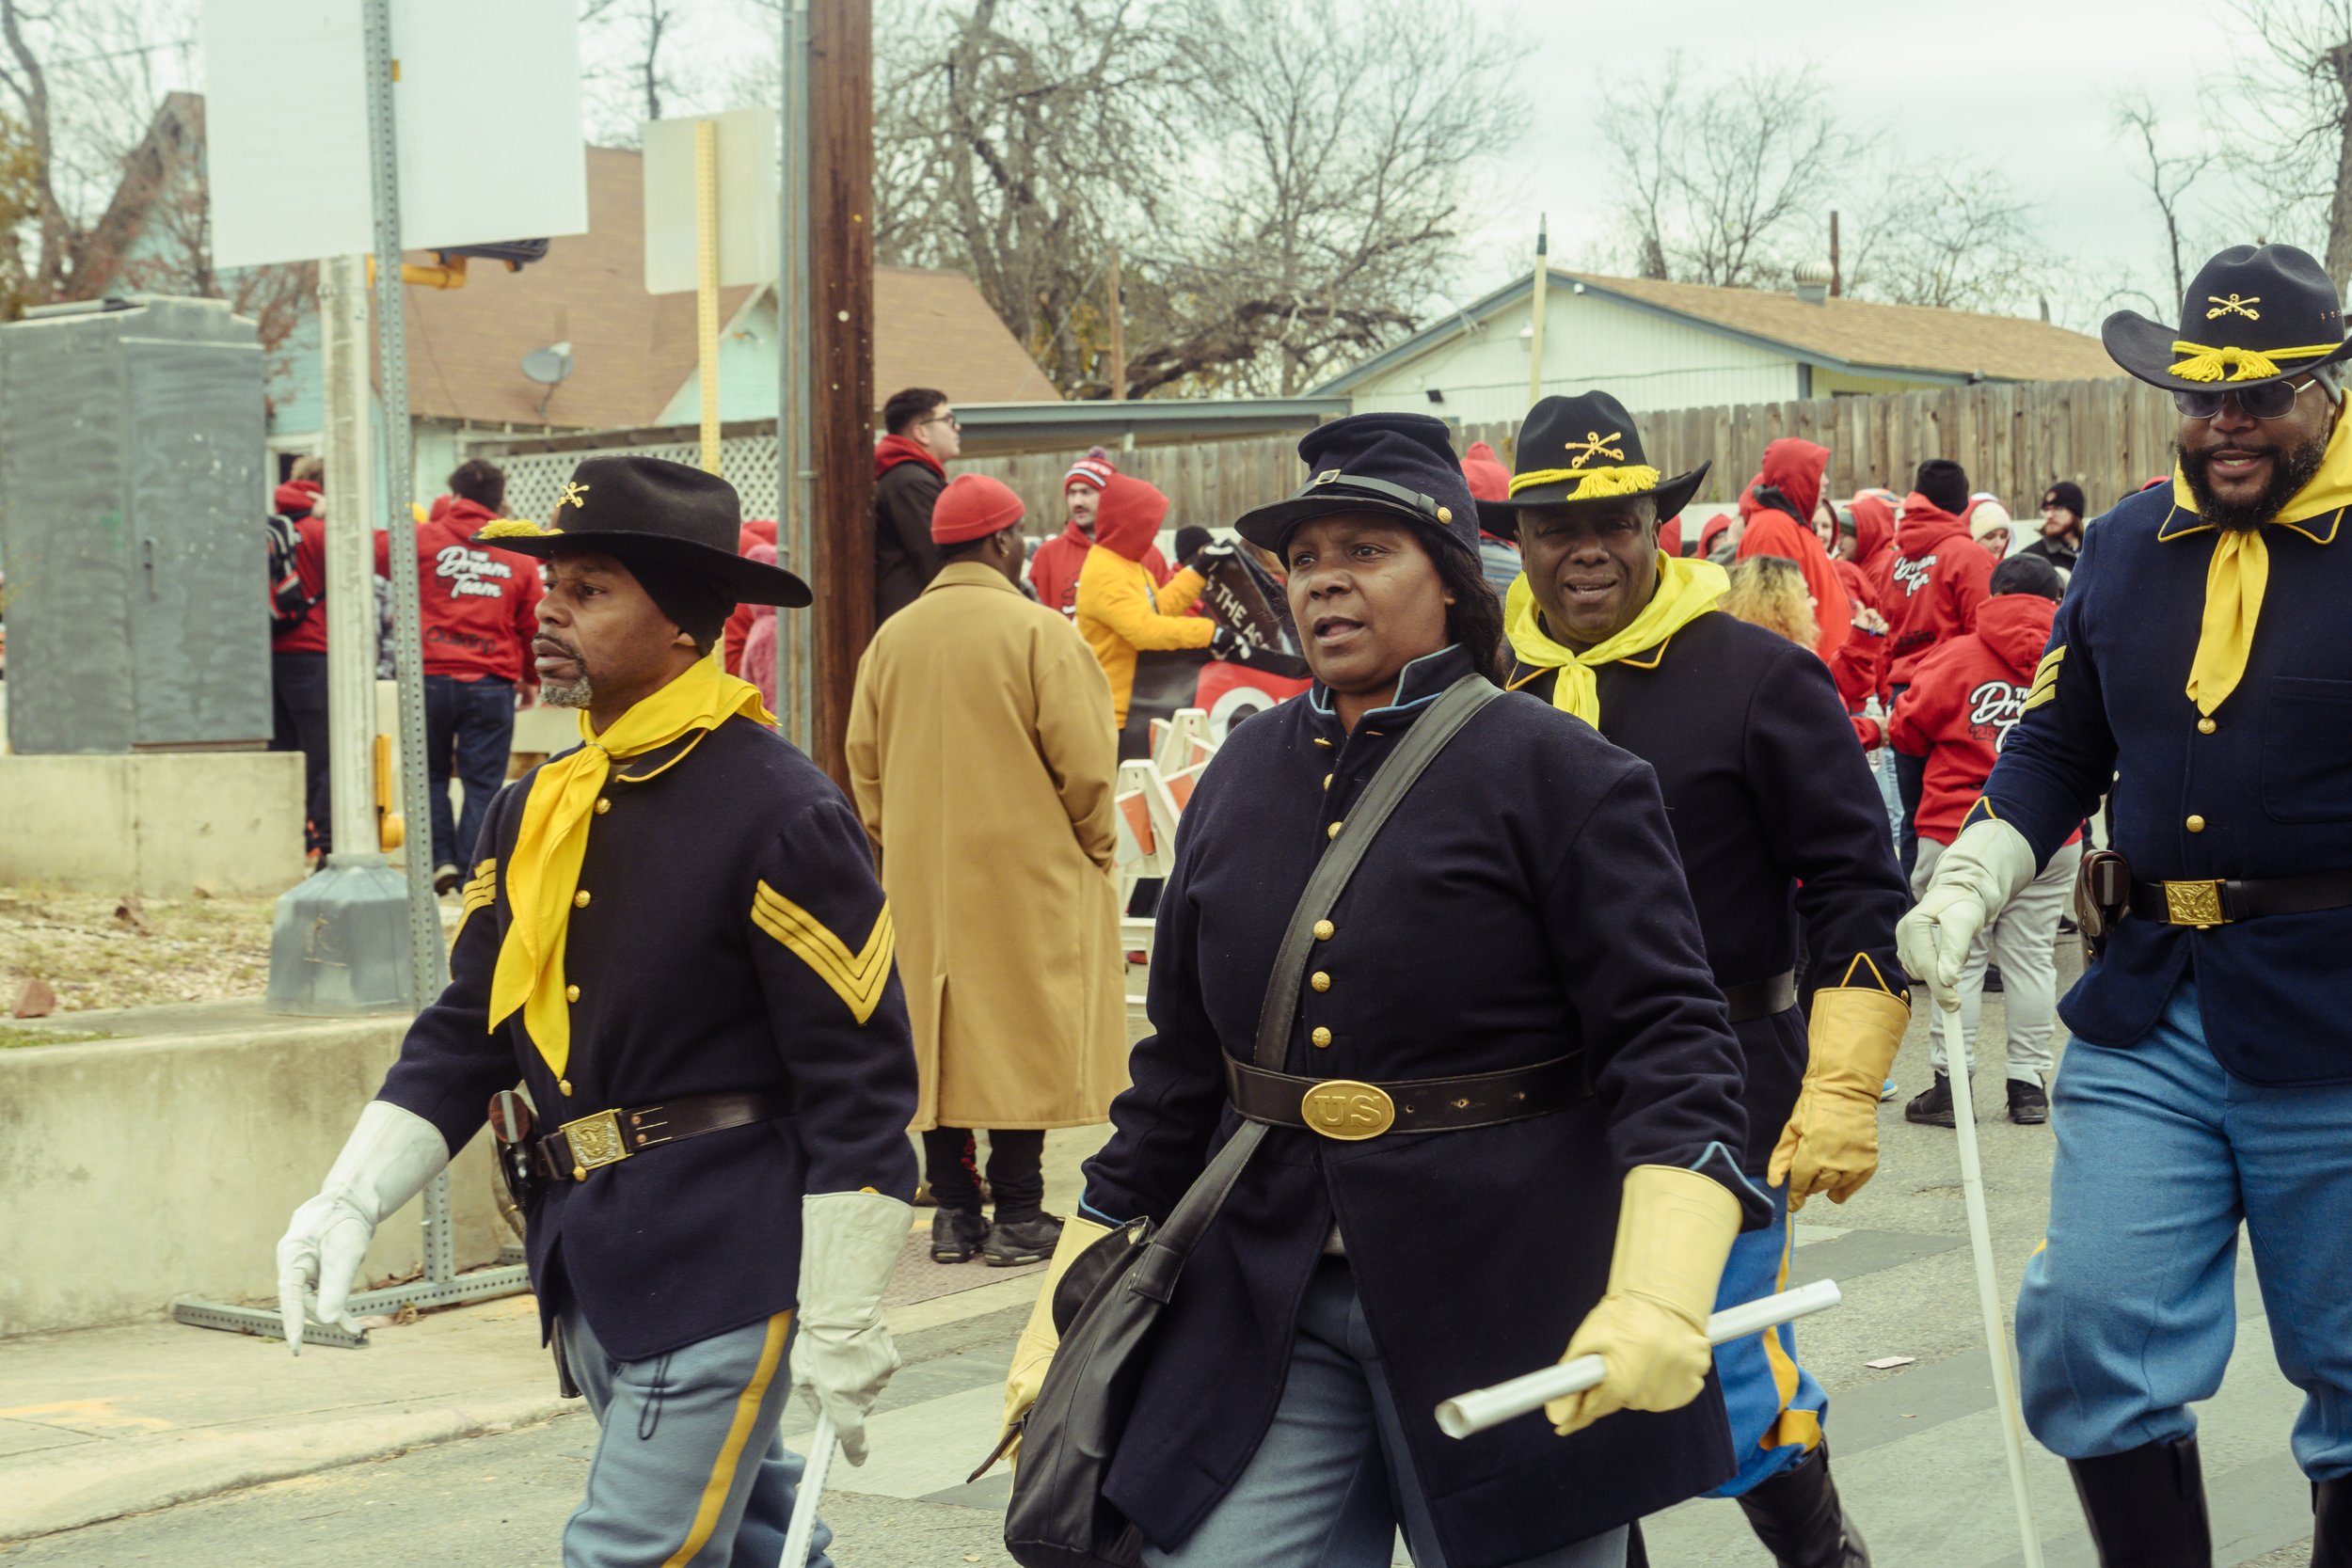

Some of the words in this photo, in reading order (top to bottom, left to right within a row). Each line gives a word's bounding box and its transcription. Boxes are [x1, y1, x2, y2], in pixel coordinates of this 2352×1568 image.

[436, 546, 513, 579] Dream
[451, 572, 502, 599] Team
[1216, 582, 1248, 628] THE
[1314, 1095, 1382, 1128] US
